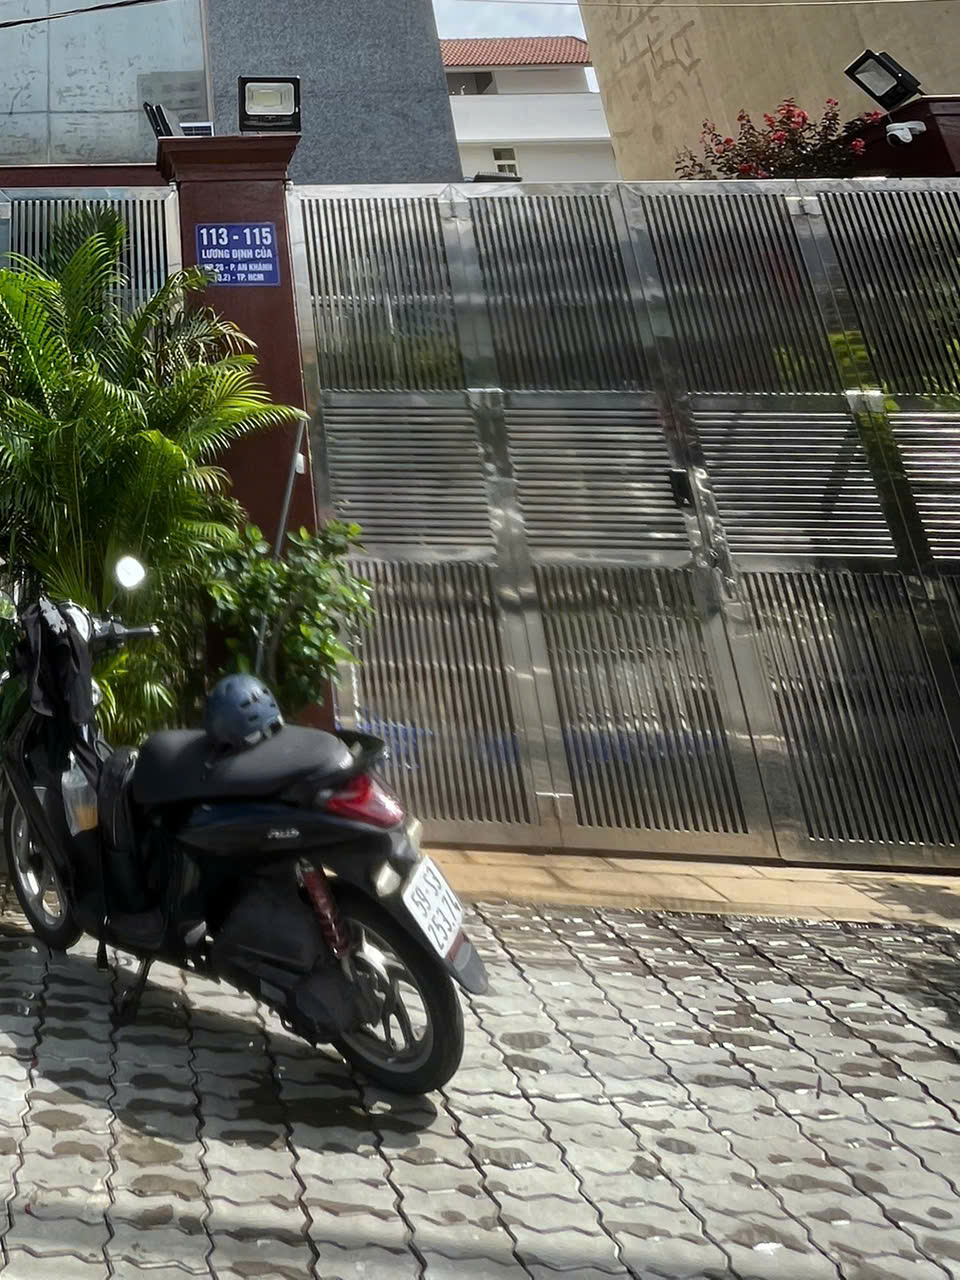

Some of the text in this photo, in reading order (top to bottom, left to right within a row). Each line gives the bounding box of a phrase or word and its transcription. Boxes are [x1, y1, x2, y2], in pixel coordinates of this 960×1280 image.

[200, 227, 228, 245] 113
[243, 227, 272, 245] 115
[232, 248, 253, 260] ĐỊNH
[255, 246, 273, 259] CỦA
[230, 263, 236, 271] P.
[237, 263, 247, 271] AN
[237, 273, 246, 282] TP.
